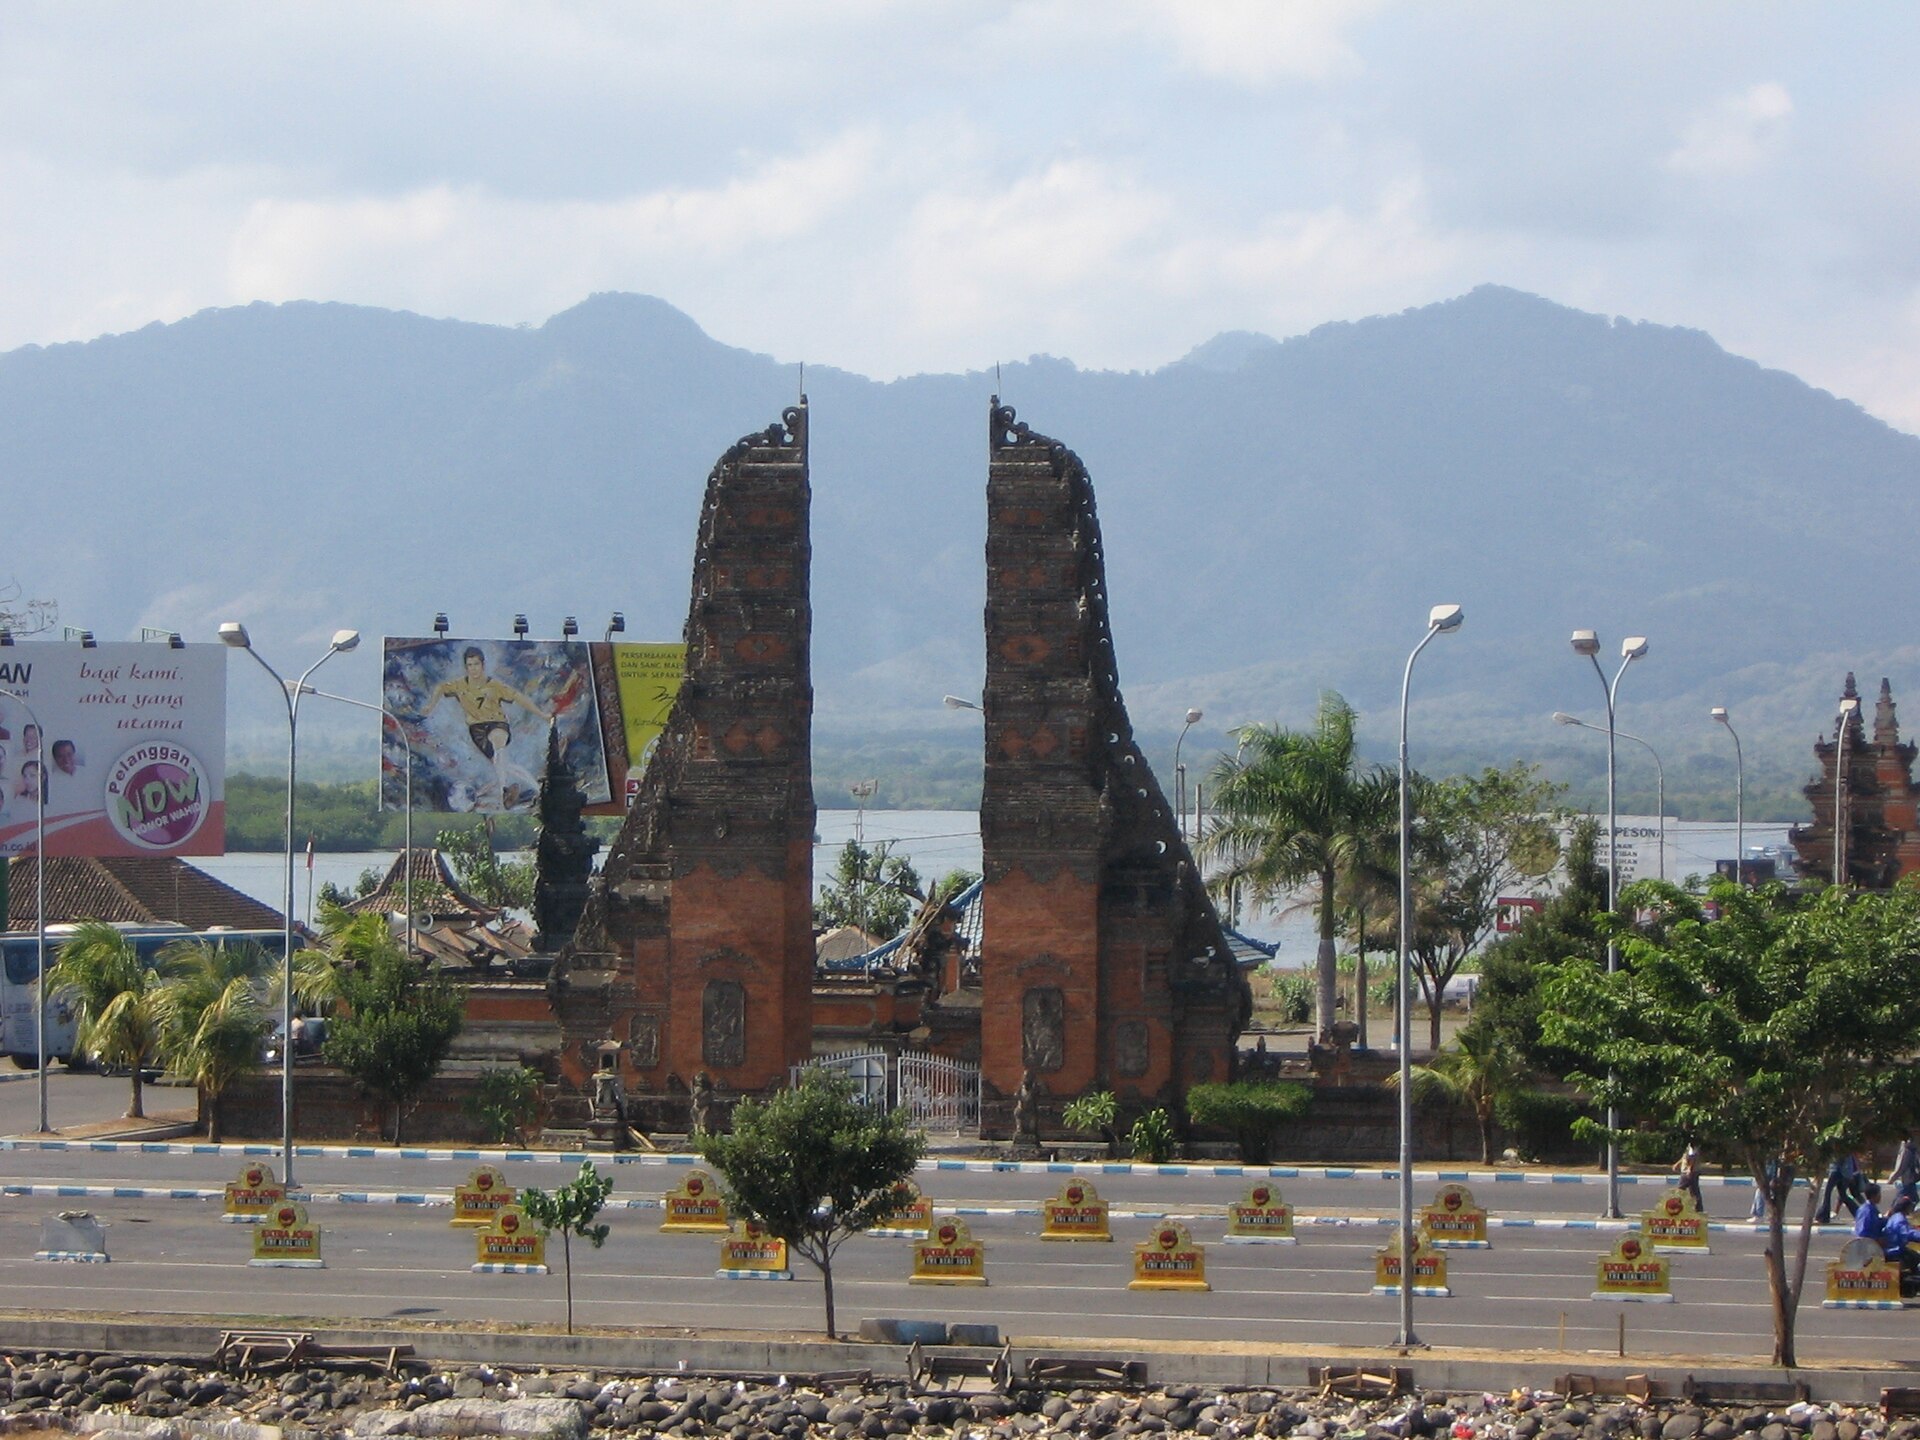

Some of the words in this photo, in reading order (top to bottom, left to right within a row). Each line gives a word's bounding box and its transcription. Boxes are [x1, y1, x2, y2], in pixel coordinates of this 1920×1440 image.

[80, 662, 121, 684] bagi
[79, 688, 126, 704] anda
[132, 695, 184, 709] yang
[476, 696, 485, 710] 7
[117, 718, 183, 730] utama
[108, 746, 190, 795] Pelanggan
[117, 767, 199, 828] NOW
